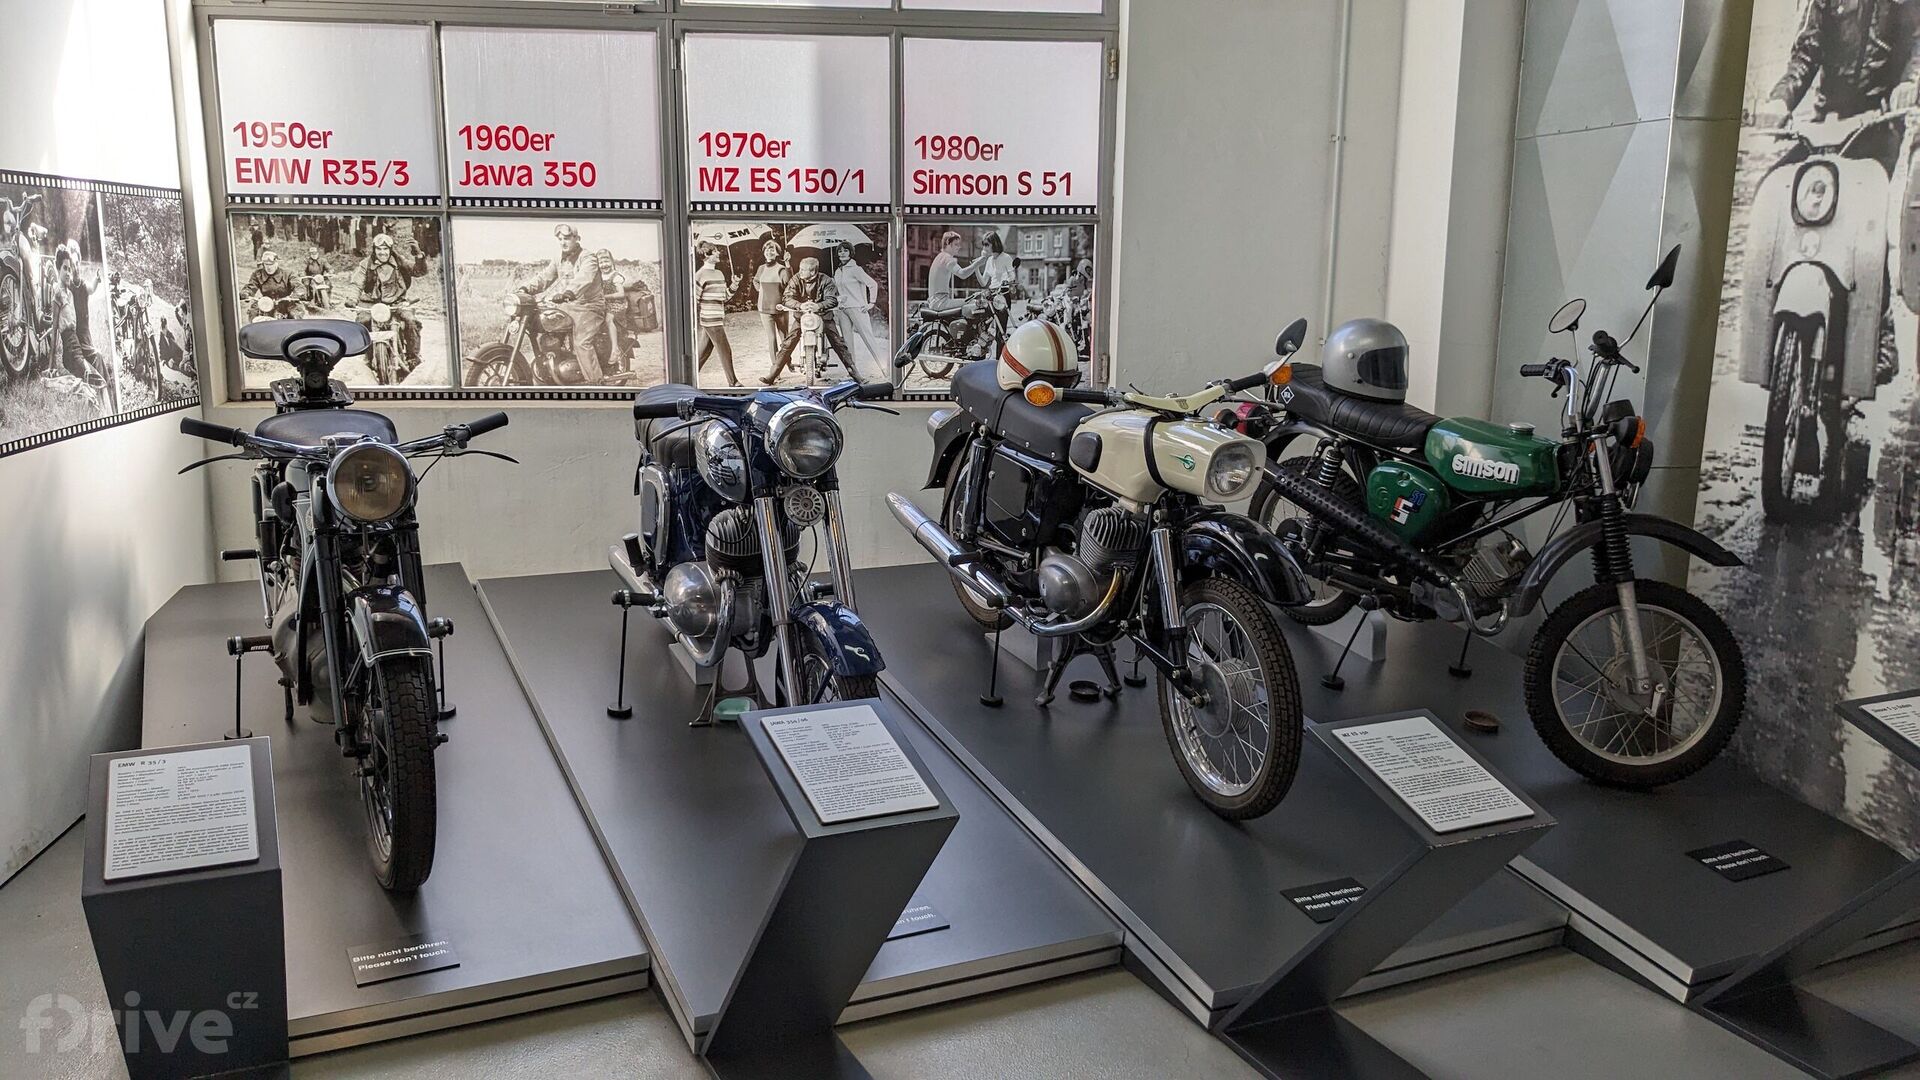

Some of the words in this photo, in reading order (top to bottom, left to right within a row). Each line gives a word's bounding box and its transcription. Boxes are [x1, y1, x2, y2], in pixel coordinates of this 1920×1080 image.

[233, 121, 333, 149] 1950er
[458, 125, 555, 151] 1960er
[698, 132, 791, 158] 1970er
[914, 135, 1004, 161] 1980er
[235, 157, 311, 184] EMW
[322, 159, 410, 188] R35/3
[459, 160, 533, 186] Jawa
[543, 161, 596, 187] 350
[699, 167, 740, 192] MZ
[751, 168, 782, 193] ES
[787, 168, 865, 196] 150/1
[912, 169, 1008, 196] Simson
[1017, 171, 1032, 196] S
[1042, 172, 1072, 196] 51
[1452, 454, 1521, 485] simson
[1293, 896, 1313, 904] Bitte
[1312, 892, 1331, 900] nicht
[1304, 901, 1331, 911] Please
[1330, 897, 1350, 906] don't
[352, 954, 376, 963] Bitte
[377, 948, 402, 958] nicht
[403, 940, 449, 953] berühren.
[358, 960, 391, 971] Please
[393, 954, 418, 965] don't
[419, 949, 450, 959] touch.
